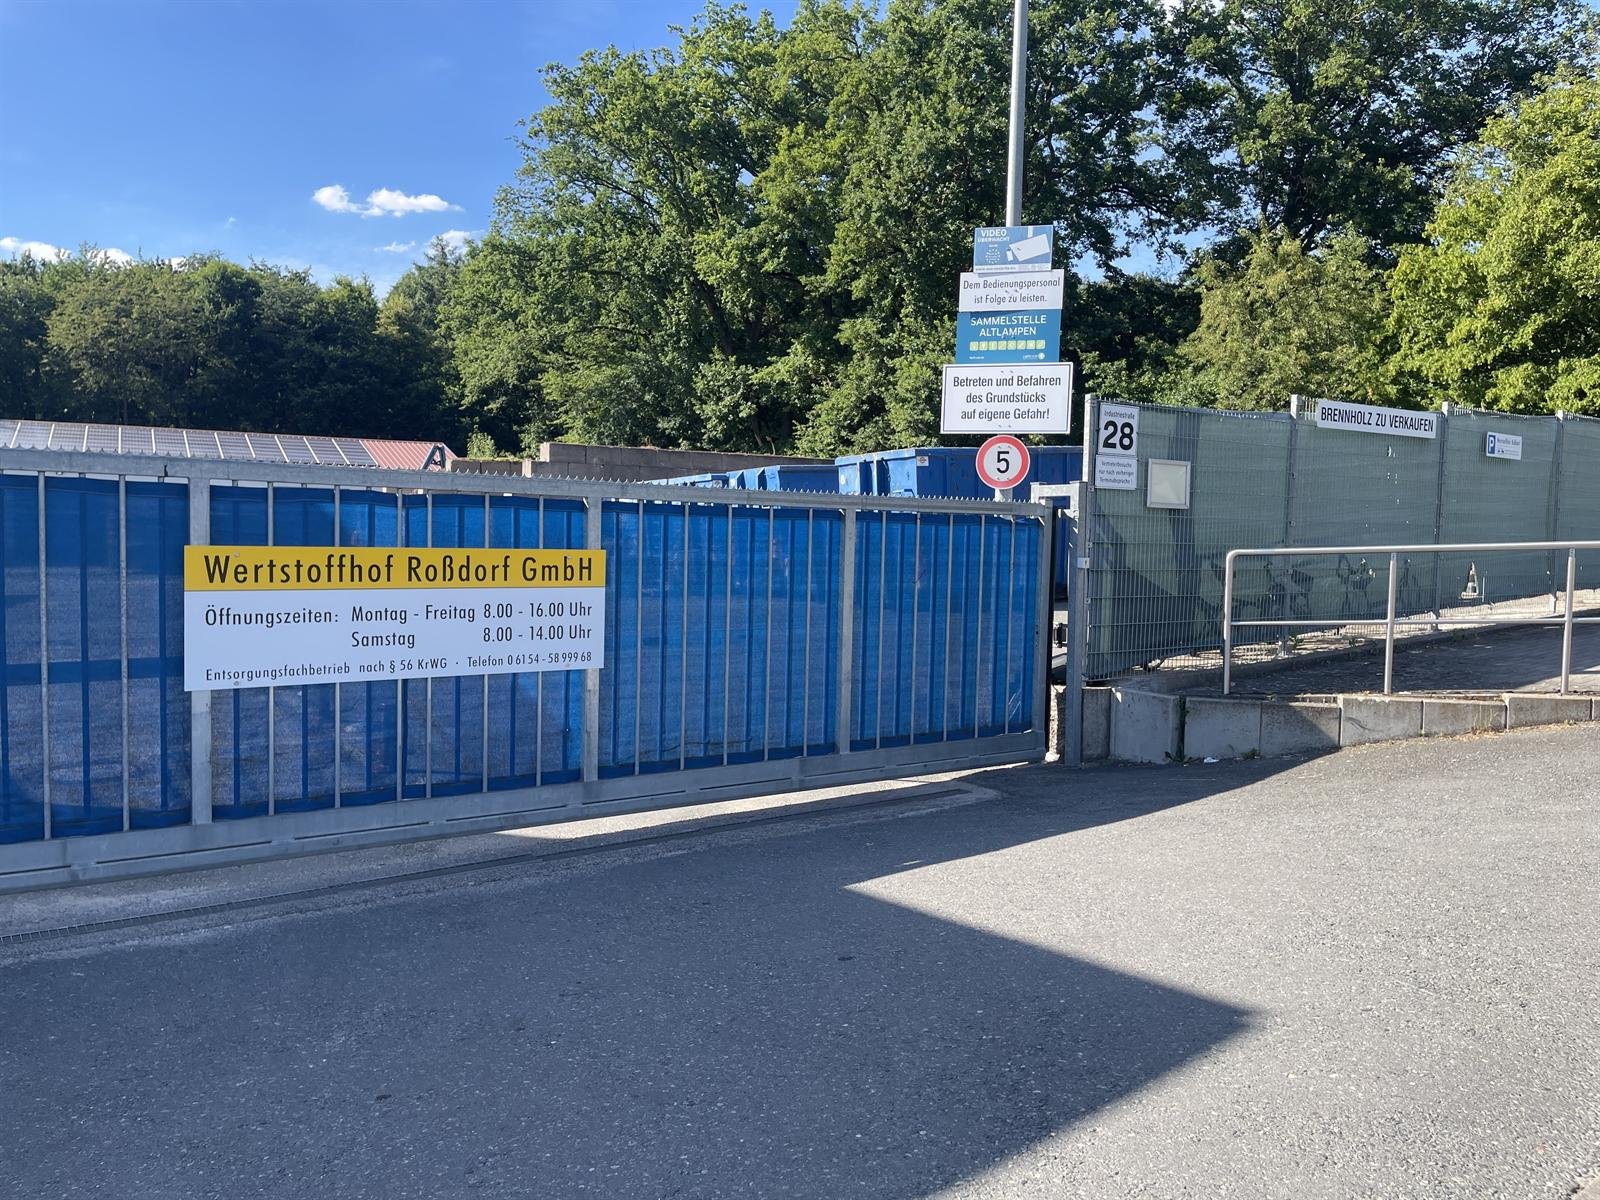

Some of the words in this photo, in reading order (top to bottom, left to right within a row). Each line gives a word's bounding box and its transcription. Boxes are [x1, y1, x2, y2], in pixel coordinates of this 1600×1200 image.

[981, 229, 1007, 237] VIDEO
[963, 280, 981, 290] Dem
[983, 277, 1061, 290] Bedienungspersonal
[974, 295, 983, 304] ist
[985, 294, 1006, 305] Folge
[1019, 293, 1047, 303] leisten.
[970, 315, 1047, 326] SAMMELSTELLE
[979, 327, 1037, 337] ALTLAMPEN
[953, 376, 993, 387] Betreten
[996, 376, 1014, 387] und
[1016, 375, 1061, 387] Befahren
[966, 392, 983, 403] des
[985, 391, 1046, 403] Grundstücks
[960, 409, 976, 420] auf
[978, 409, 1011, 421] eigene
[1013, 408, 1050, 419] Gefahr!
[1321, 406, 1373, 426] BRENNHOLZ
[1375, 413, 1387, 427] ZU
[1389, 414, 1434, 432] VERKAUFEN
[1102, 420, 1134, 451] 28
[996, 451, 1010, 474] 5
[204, 554, 394, 583] Wertstoffhof
[407, 555, 510, 582] Roßdorf
[522, 556, 592, 581] GmbH
[205, 604, 339, 628] Öffnungszeiten:
[351, 606, 407, 624] Montag
[425, 604, 475, 622] Freitag
[483, 603, 513, 618] 8.00
[529, 602, 564, 618] 16.00
[569, 601, 593, 617] Uhr
[351, 631, 415, 649] Samstag
[483, 627, 513, 642] 8.00
[529, 625, 564, 641] 14.00
[569, 624, 592, 639] Uhr
[206, 662, 350, 681] Entsorgungsfachbetrieb
[359, 661, 385, 673] nach
[389, 660, 396, 673] §
[400, 659, 413, 671] 56
[418, 658, 447, 669] KrWG
[467, 654, 504, 668] Telefon
